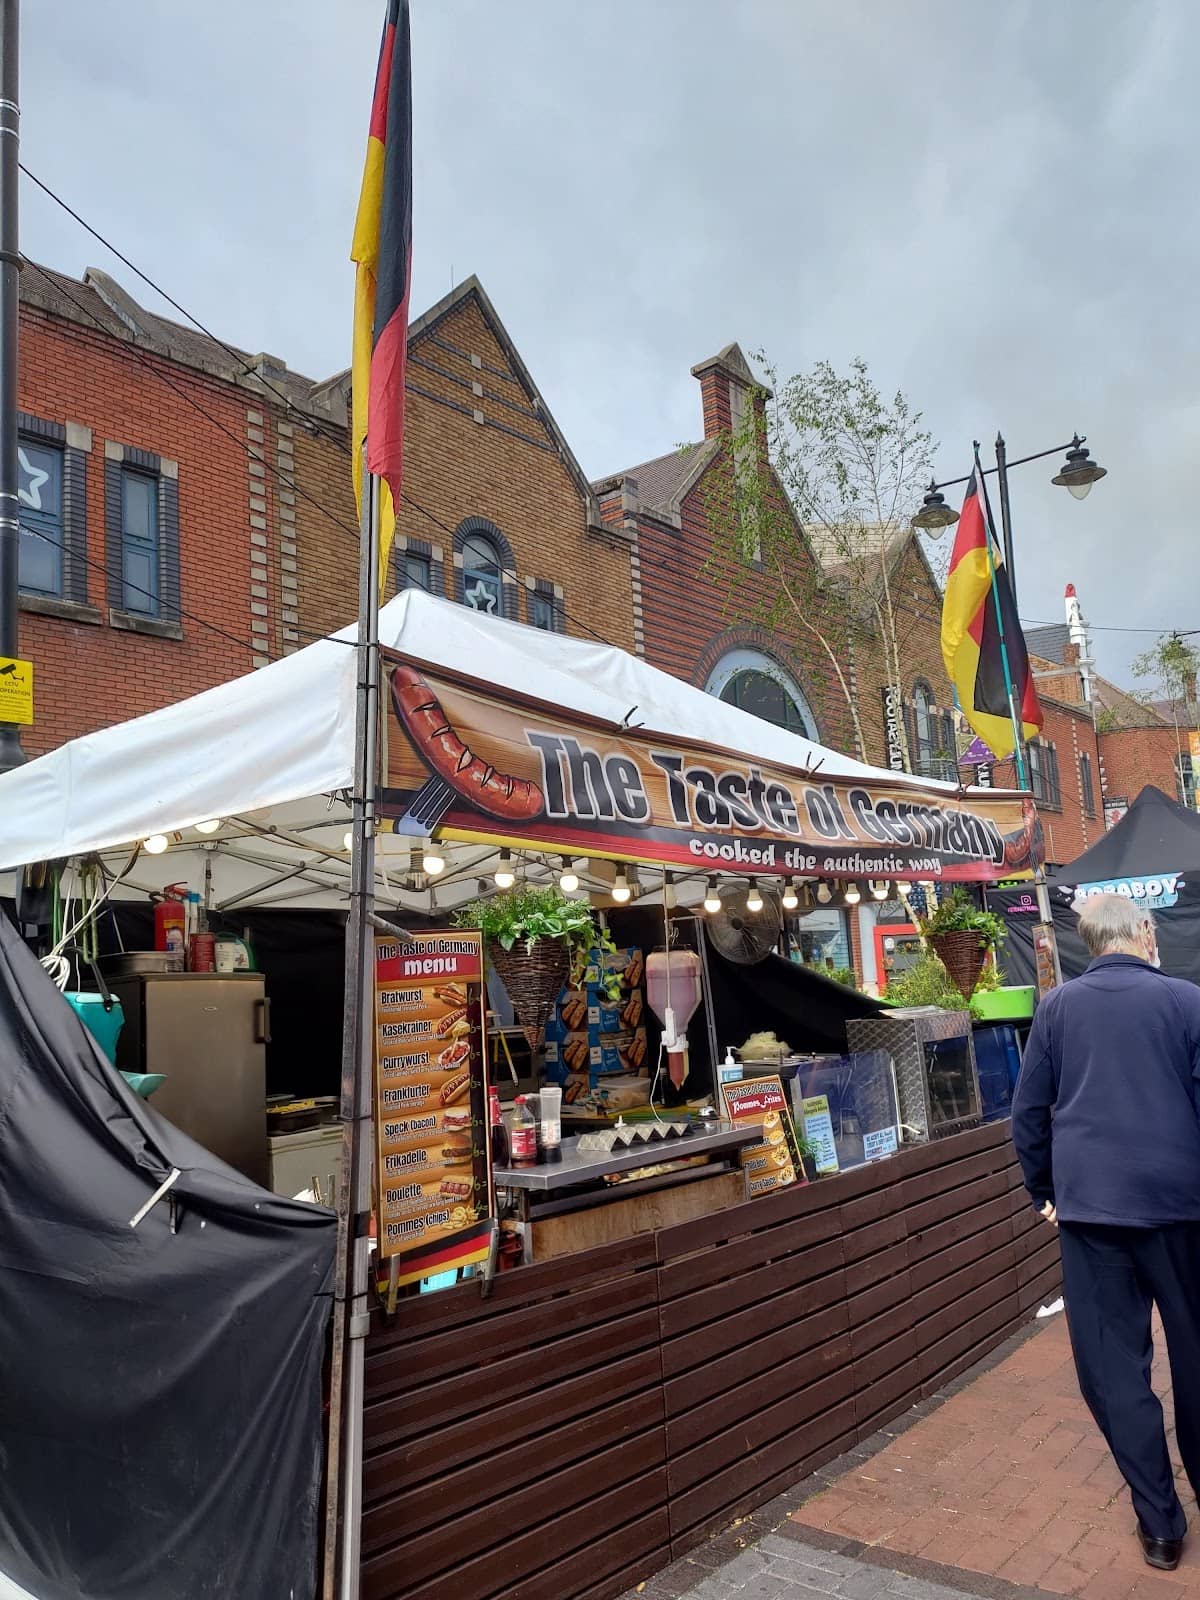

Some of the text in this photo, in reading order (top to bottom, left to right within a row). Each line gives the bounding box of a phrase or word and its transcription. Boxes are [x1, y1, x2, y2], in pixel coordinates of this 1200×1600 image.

[524, 728, 1005, 865] The Taste of Germany
[689, 838, 942, 876] cooked the authentic way
[379, 939, 479, 960] The Taste of Germany
[404, 957, 457, 976] menu
[381, 989, 422, 1004] Bratwurst
[382, 1021, 432, 1037] Kasekrainer
[383, 1052, 429, 1069] Currywurst
[384, 1084, 430, 1102] Frankfurter
[733, 1100, 760, 1114] Pommes
[385, 1121, 409, 1136] Speck
[410, 1115, 436, 1131] (bacon)
[385, 1149, 427, 1169] Frikadelle
[386, 1183, 421, 1203] Boulette
[387, 1209, 450, 1237] Pommes (chips)
